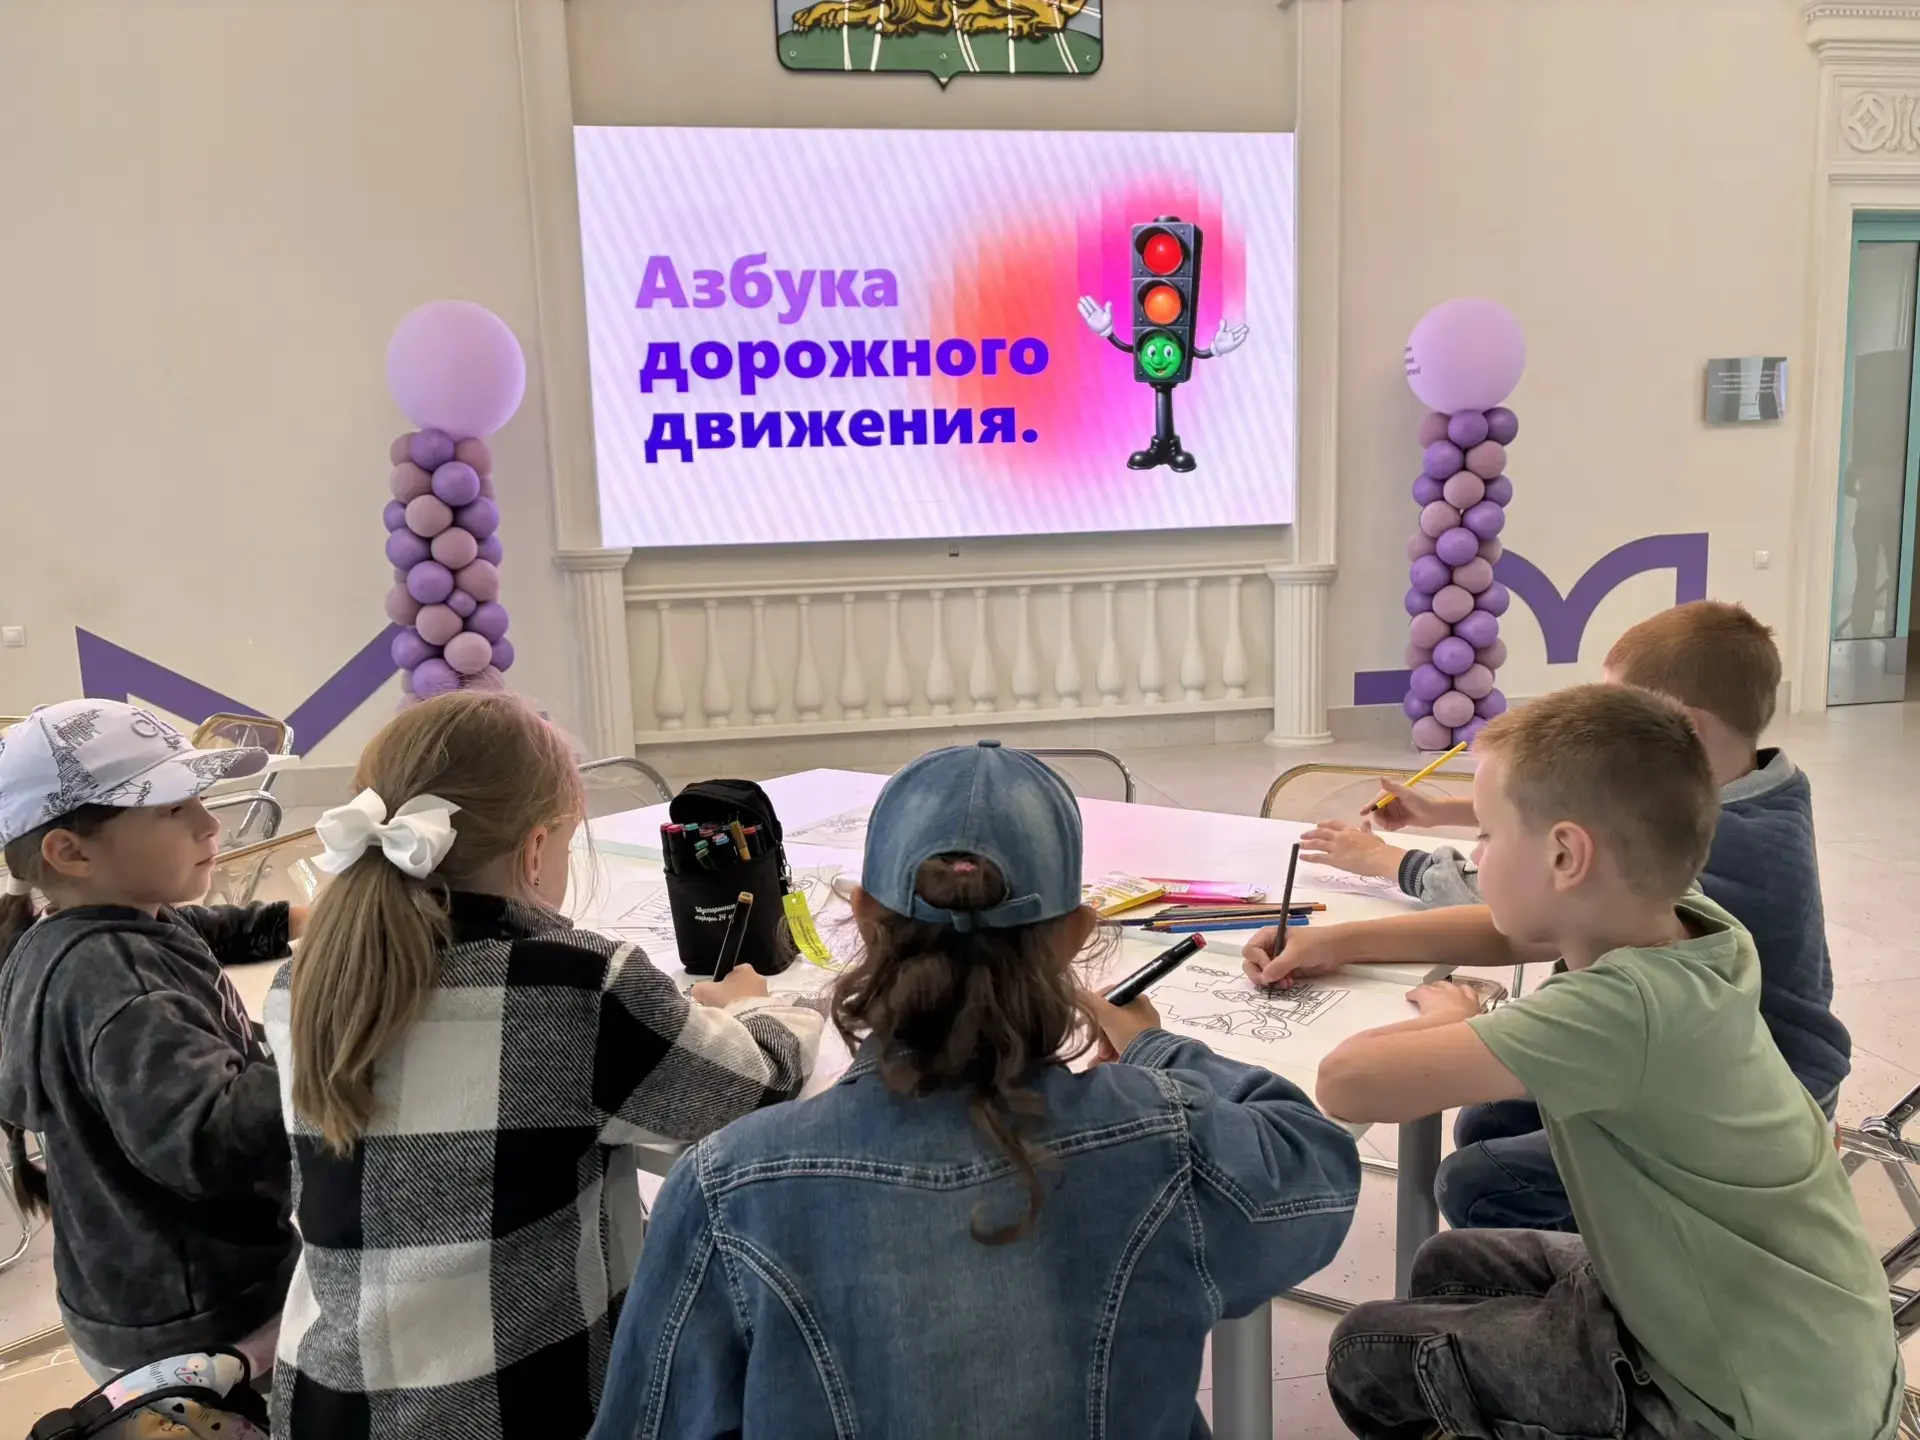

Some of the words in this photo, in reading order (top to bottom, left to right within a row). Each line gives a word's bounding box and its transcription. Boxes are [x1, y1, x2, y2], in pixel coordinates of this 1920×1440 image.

[635, 252, 898, 325] Азбука
[639, 337, 1050, 395] дорожного
[644, 407, 1039, 463] движения.
